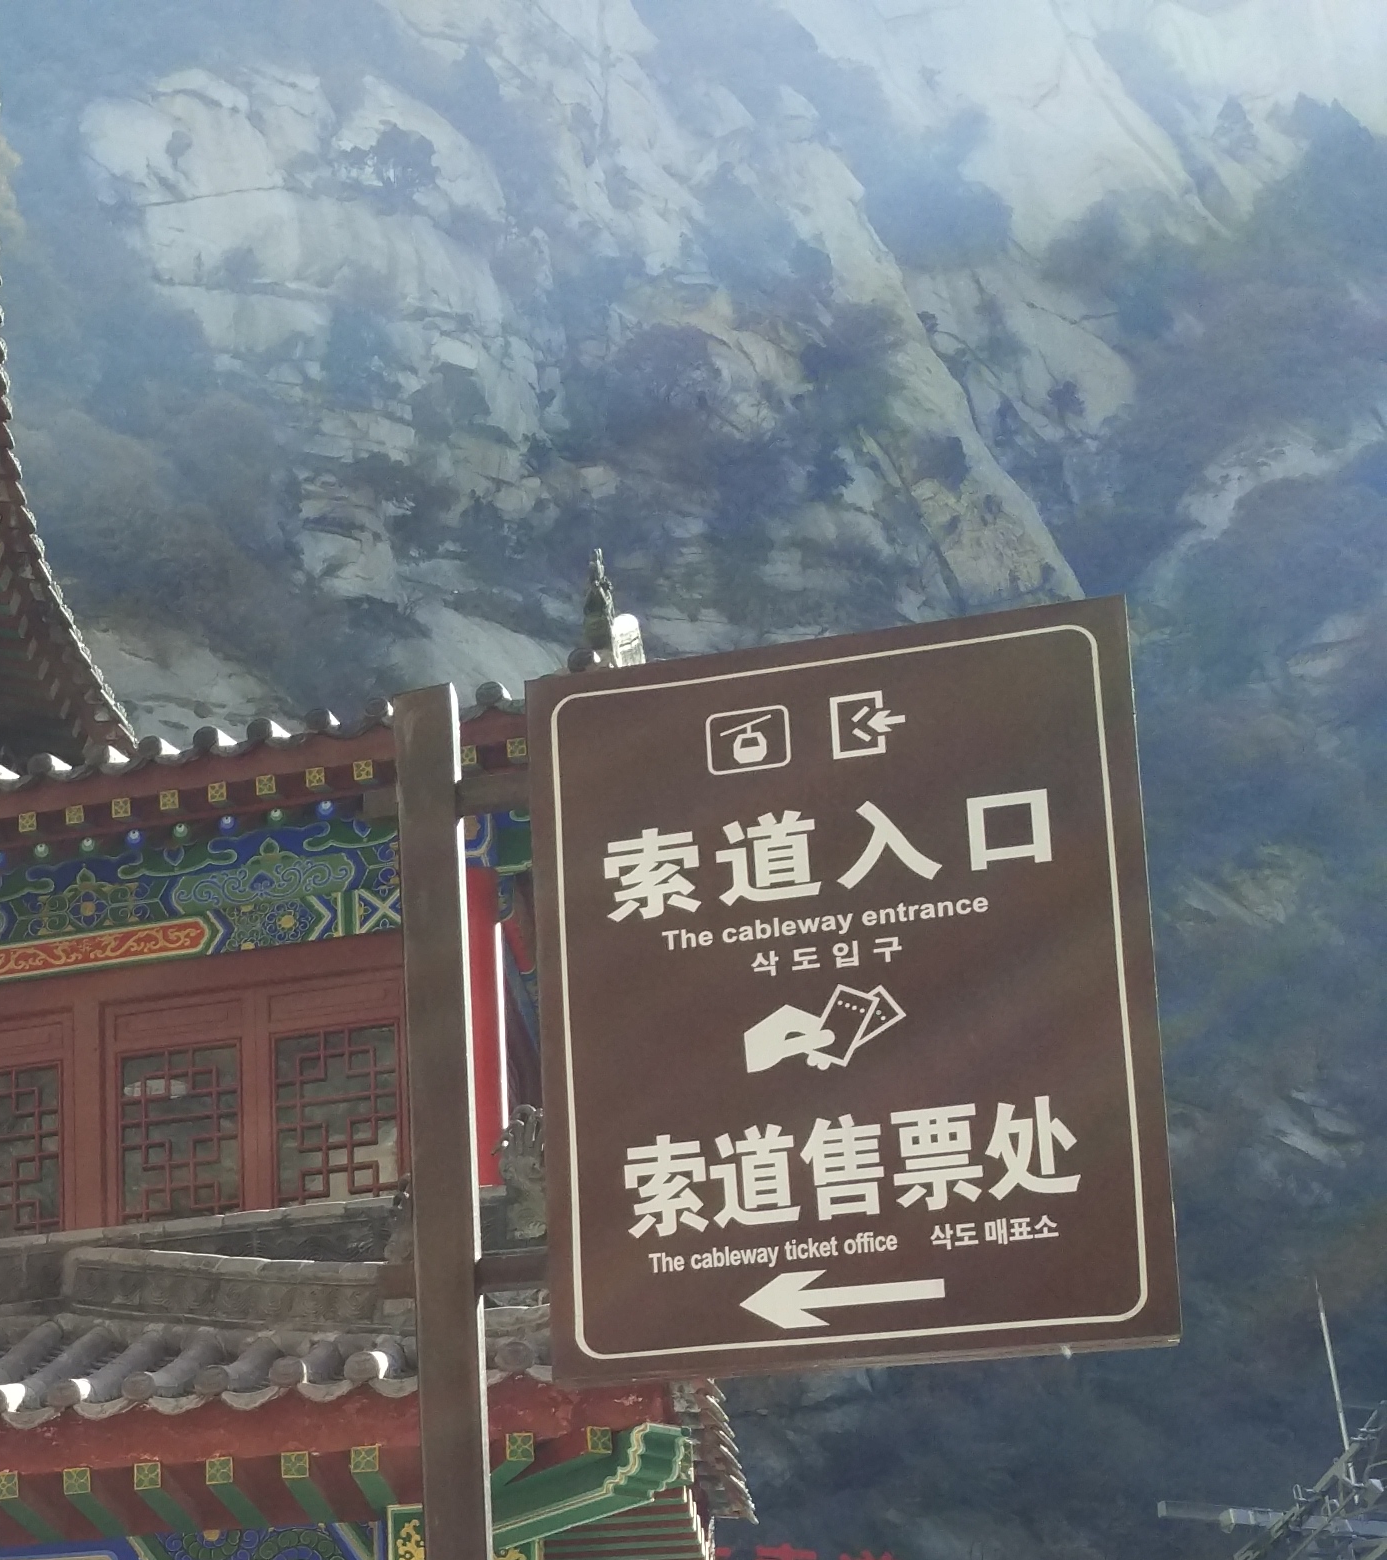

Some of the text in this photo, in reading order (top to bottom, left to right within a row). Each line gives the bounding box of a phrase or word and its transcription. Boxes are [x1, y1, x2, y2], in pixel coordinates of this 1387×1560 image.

[603, 788, 1053, 922] 索道入口
[662, 896, 990, 951] The cableway entrance
[624, 1095, 1081, 1240] 索道售票处
[648, 1231, 899, 1274] The cableway ticket office
[930, 1215, 1060, 1250] 삭도 매표소
